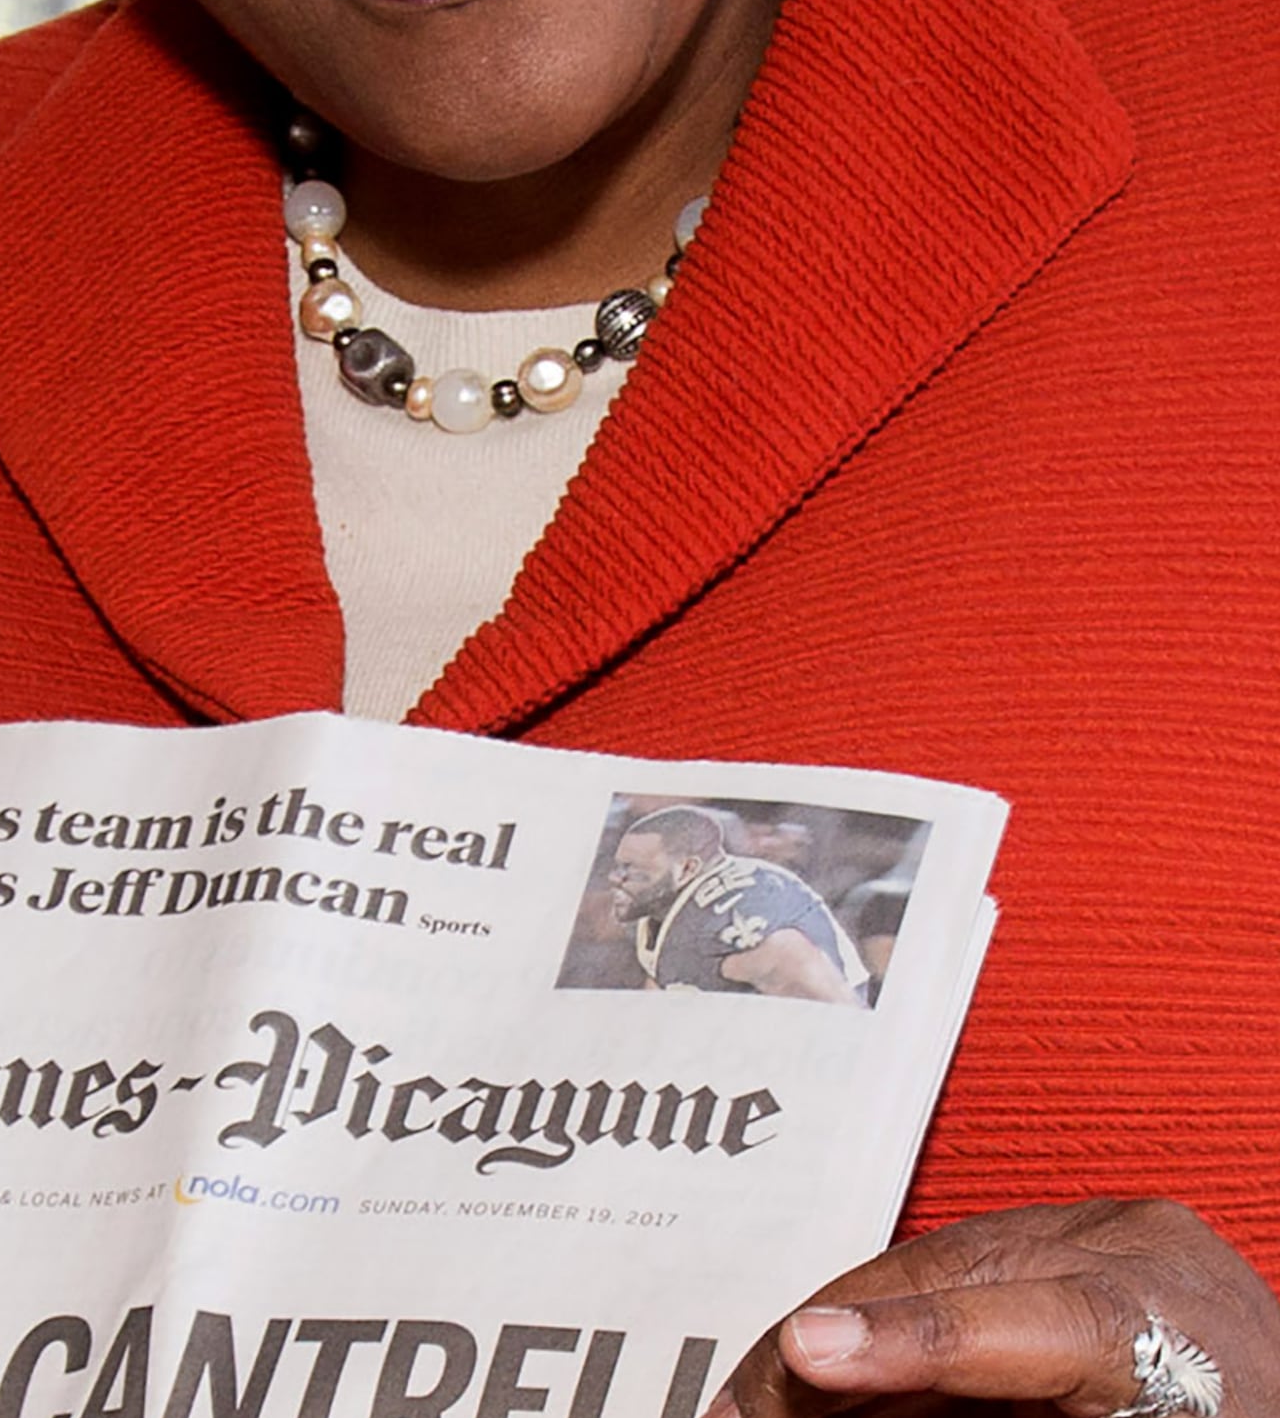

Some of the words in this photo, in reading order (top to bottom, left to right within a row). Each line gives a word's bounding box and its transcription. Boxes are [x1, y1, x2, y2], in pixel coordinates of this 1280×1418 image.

[33, 801, 193, 851] team
[201, 796, 248, 847] is
[256, 786, 365, 846] the
[374, 821, 517, 872] real
[27, 867, 164, 917] Jeff
[158, 865, 410, 926] Duncan
[418, 914, 492, 937] Sports
[19, 1190, 82, 1208] LOCAL
[88, 1187, 142, 1207] NEWS
[144, 1182, 168, 1200] AT
[187, 1174, 341, 1215] nola.com
[457, 1200, 579, 1222] NOVEMBER
[625, 1209, 678, 1229] 2017
